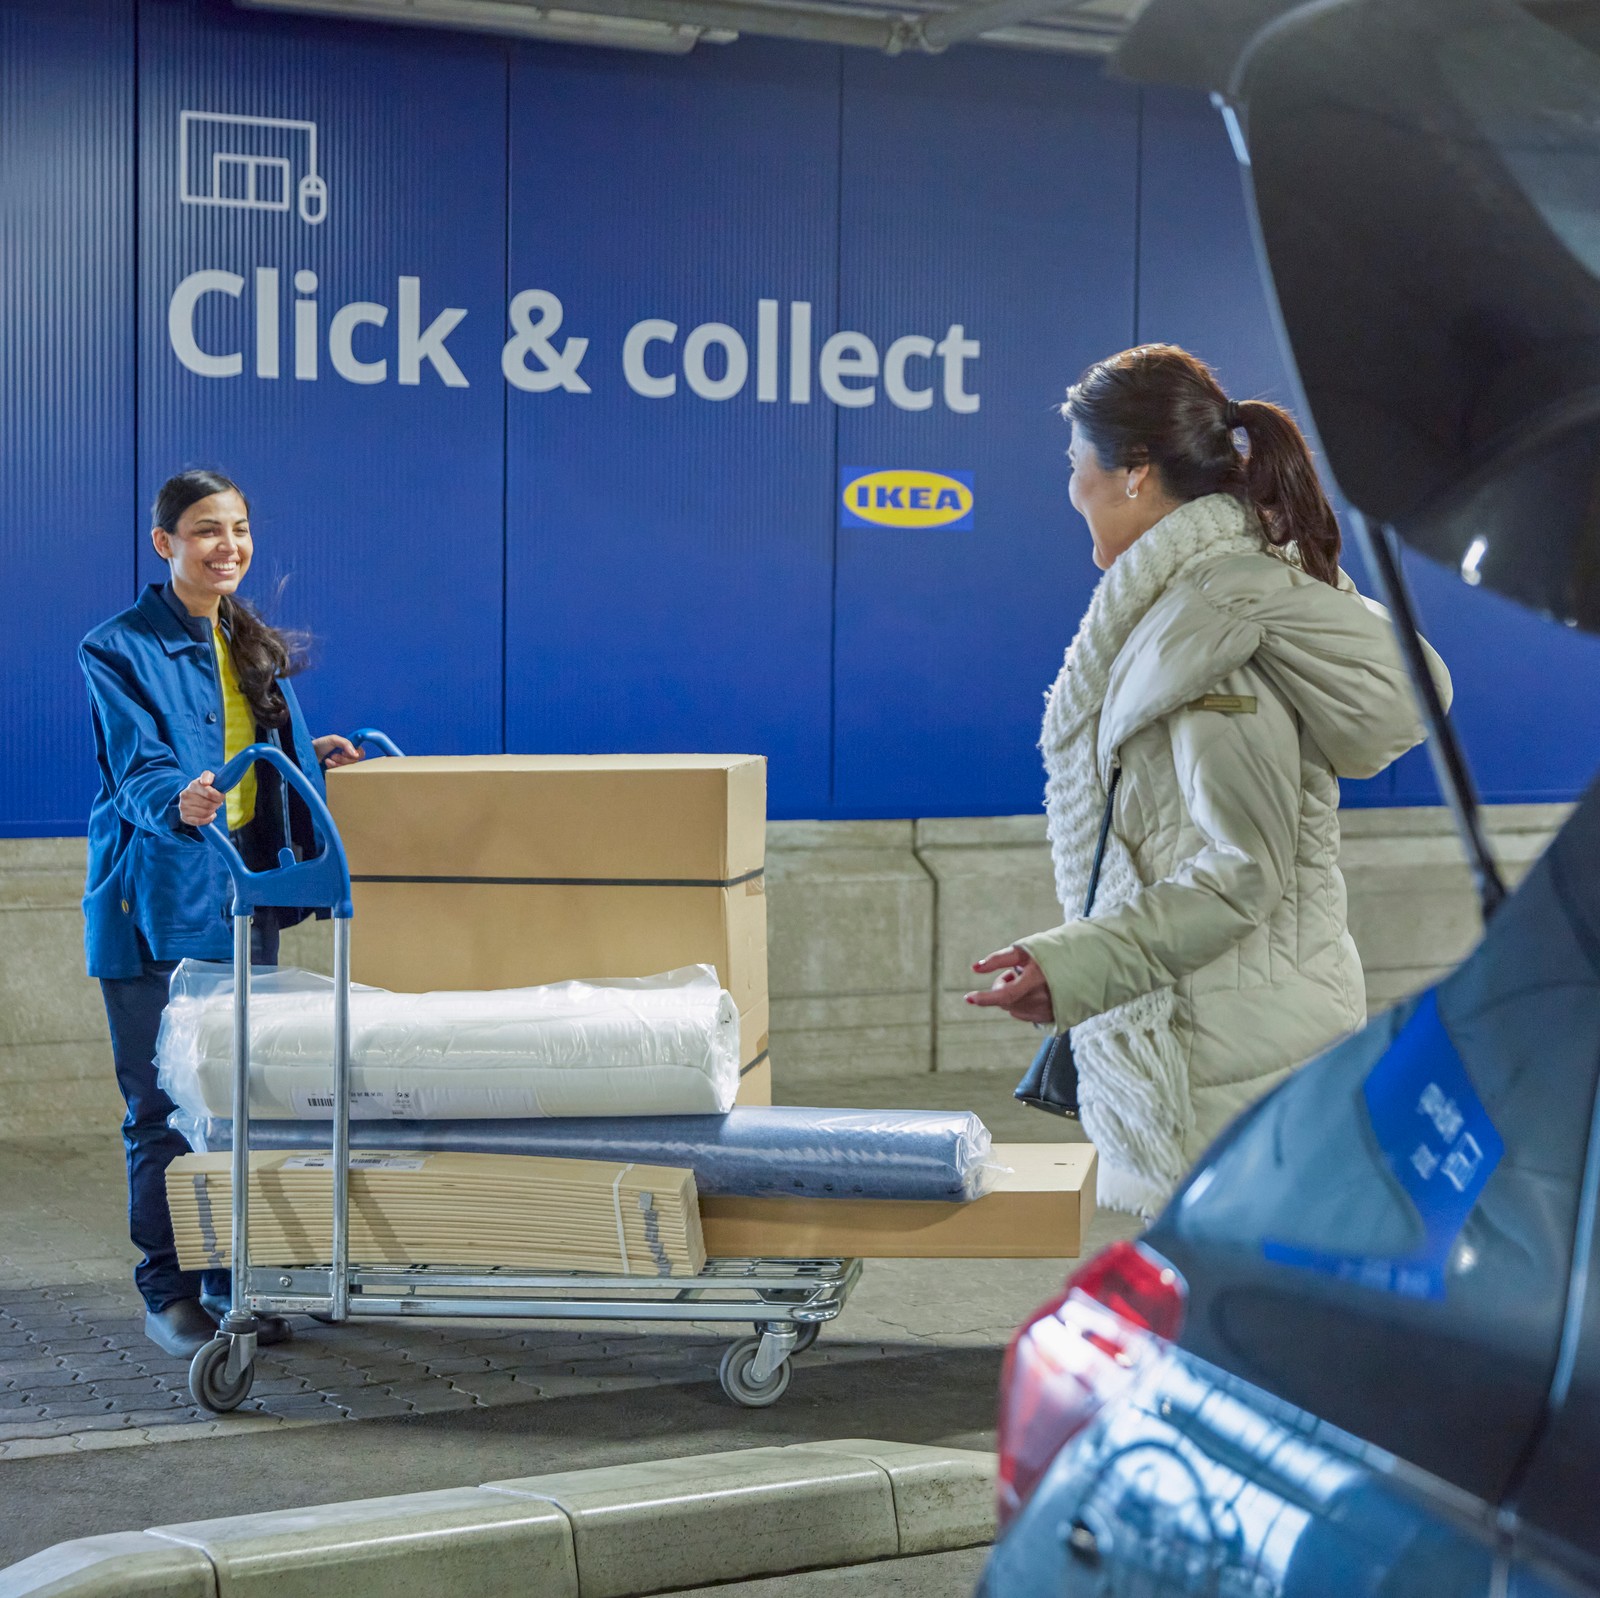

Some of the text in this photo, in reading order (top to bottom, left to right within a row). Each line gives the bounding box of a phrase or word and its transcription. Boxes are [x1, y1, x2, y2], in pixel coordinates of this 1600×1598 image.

[168, 267, 981, 414] Click & collect
[857, 485, 963, 511] IKEA
